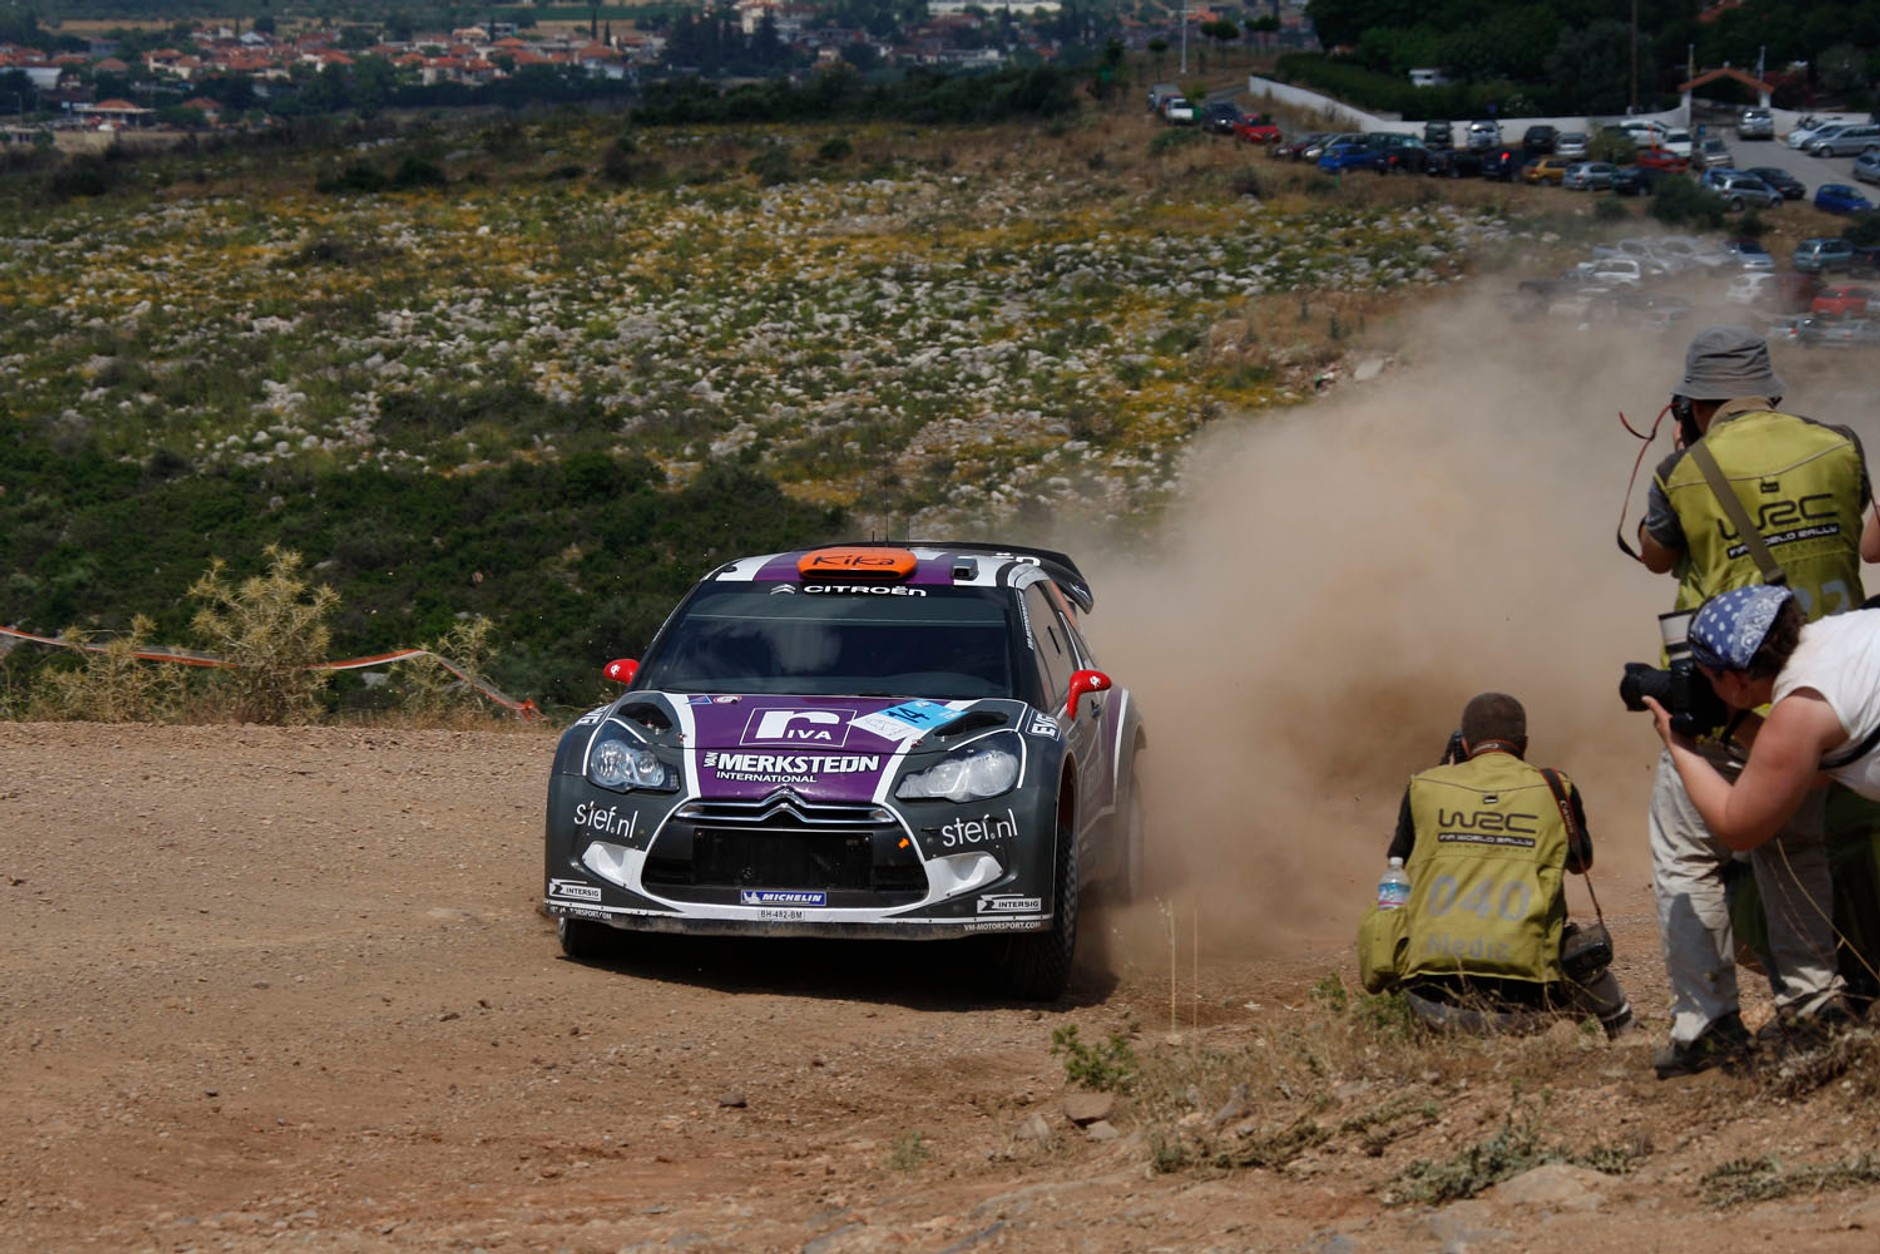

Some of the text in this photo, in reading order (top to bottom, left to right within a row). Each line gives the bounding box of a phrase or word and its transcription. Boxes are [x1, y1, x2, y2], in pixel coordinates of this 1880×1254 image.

[813, 556, 896, 566] Kika
[886, 707, 931, 724] 14
[716, 771, 817, 783] INTERNATIONAL
[1438, 808, 1539, 834] WRC
[761, 893, 823, 902] MICHELIN
[1427, 874, 1534, 922] 040
[998, 900, 1040, 909] INTERSIG
